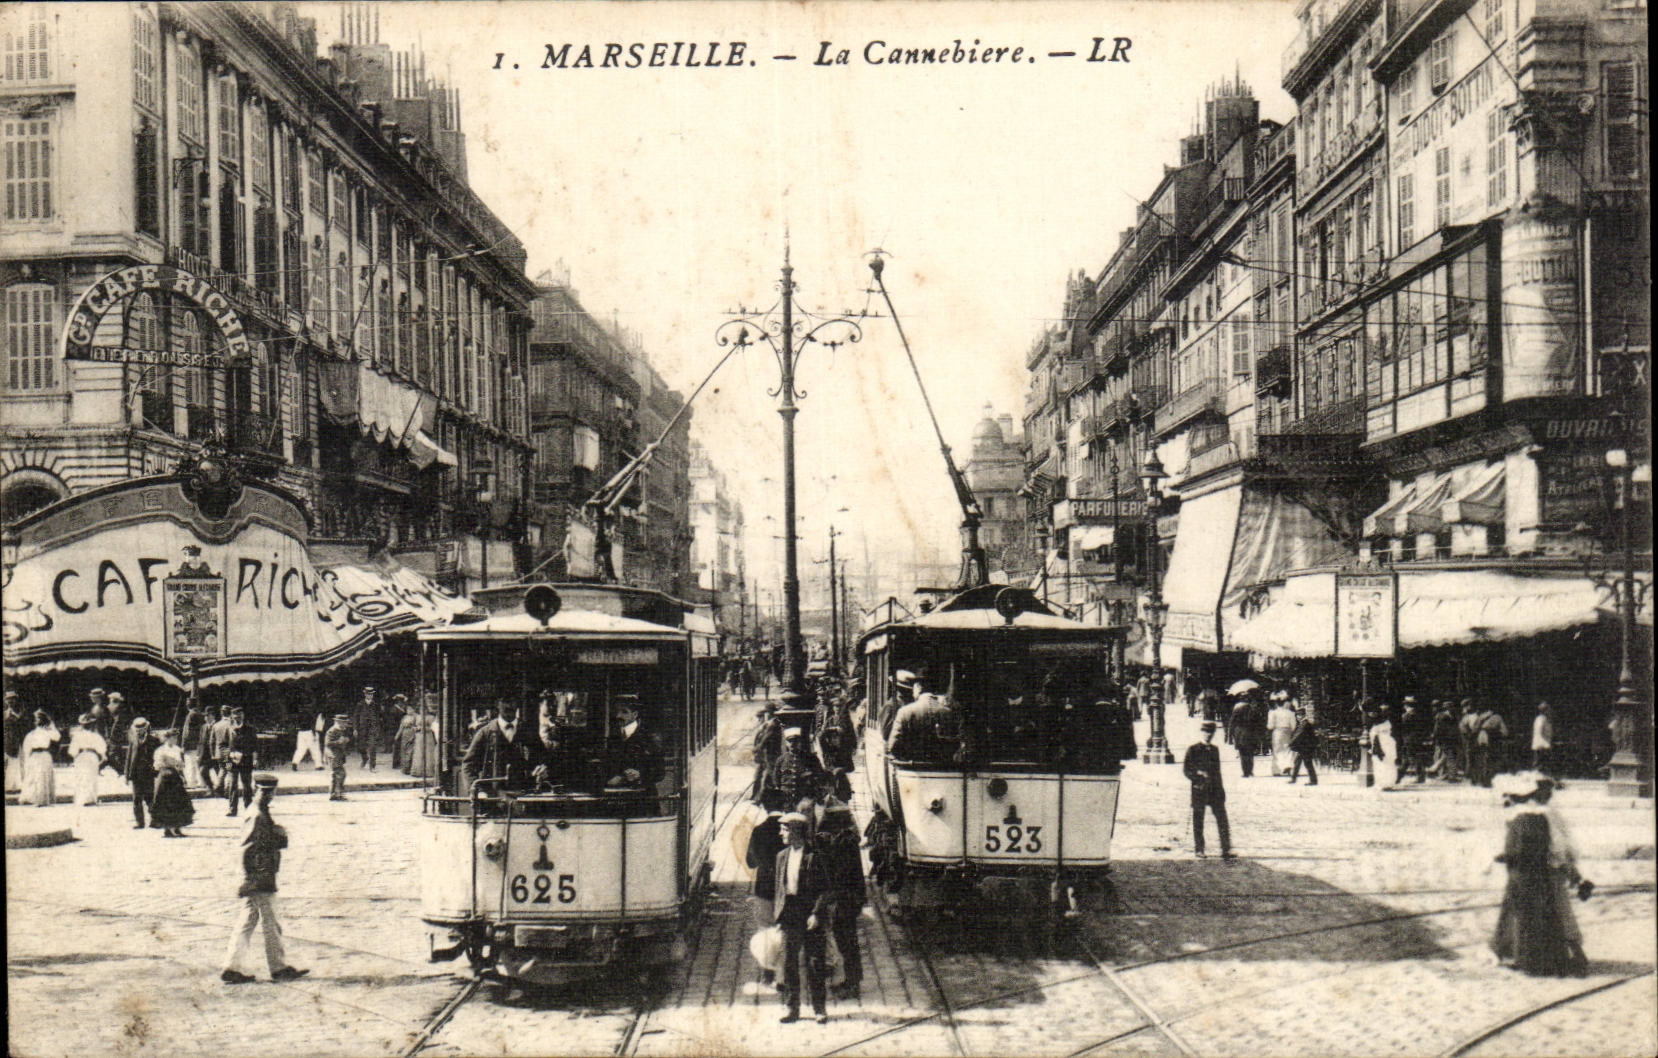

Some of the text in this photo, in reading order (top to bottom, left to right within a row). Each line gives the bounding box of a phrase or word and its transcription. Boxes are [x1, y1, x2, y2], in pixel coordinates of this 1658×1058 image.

[173, 269, 250, 356] RICHE
[985, 825, 1042, 853] 523
[510, 873, 577, 904] 625
